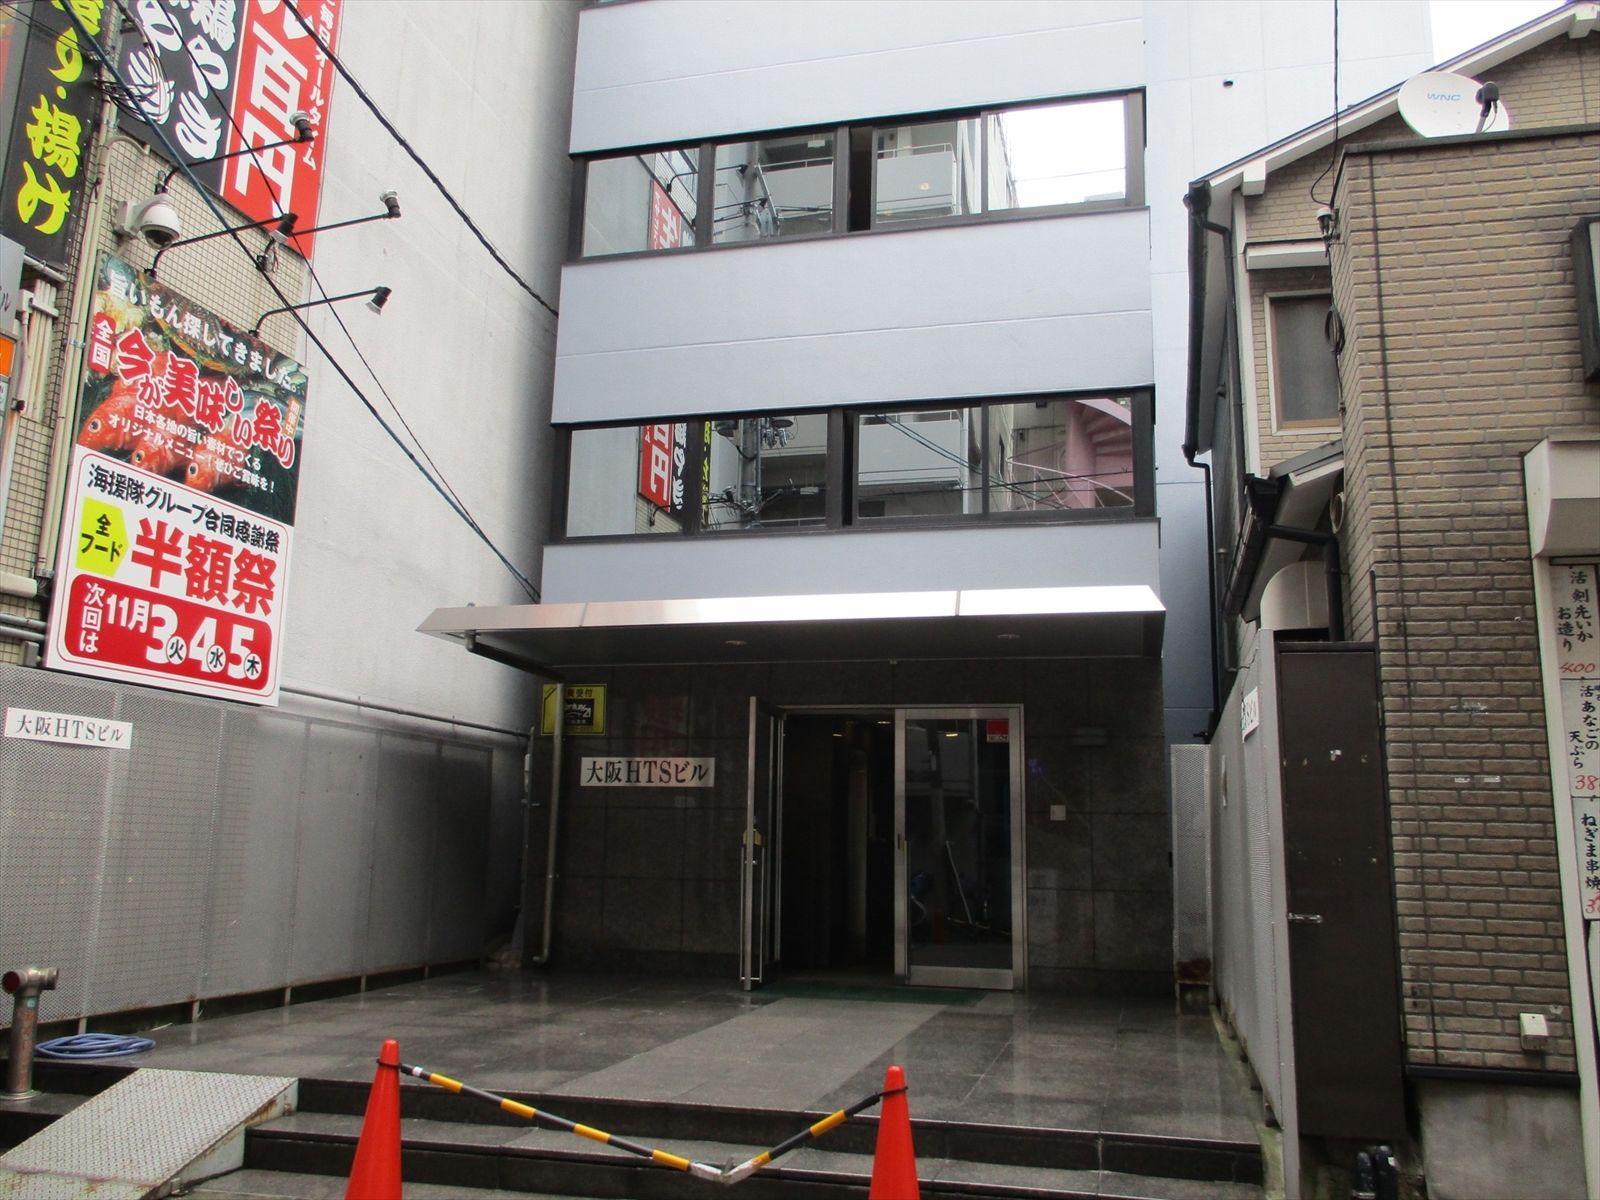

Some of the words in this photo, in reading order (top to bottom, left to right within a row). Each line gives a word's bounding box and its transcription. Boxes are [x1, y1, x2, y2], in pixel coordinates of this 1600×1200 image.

[1427, 92, 1461, 102] WNC
[91, 319, 115, 371] 全国
[87, 462, 281, 555] 海援隊グループ合同感謝祭
[95, 513, 111, 538] 全
[80, 532, 124, 563] フード
[130, 516, 278, 617] 半額祭
[79, 581, 105, 654] 次回は
[15, 713, 125, 743] 大阪HTSビル
[586, 760, 709, 784] 大阪HTSビル
